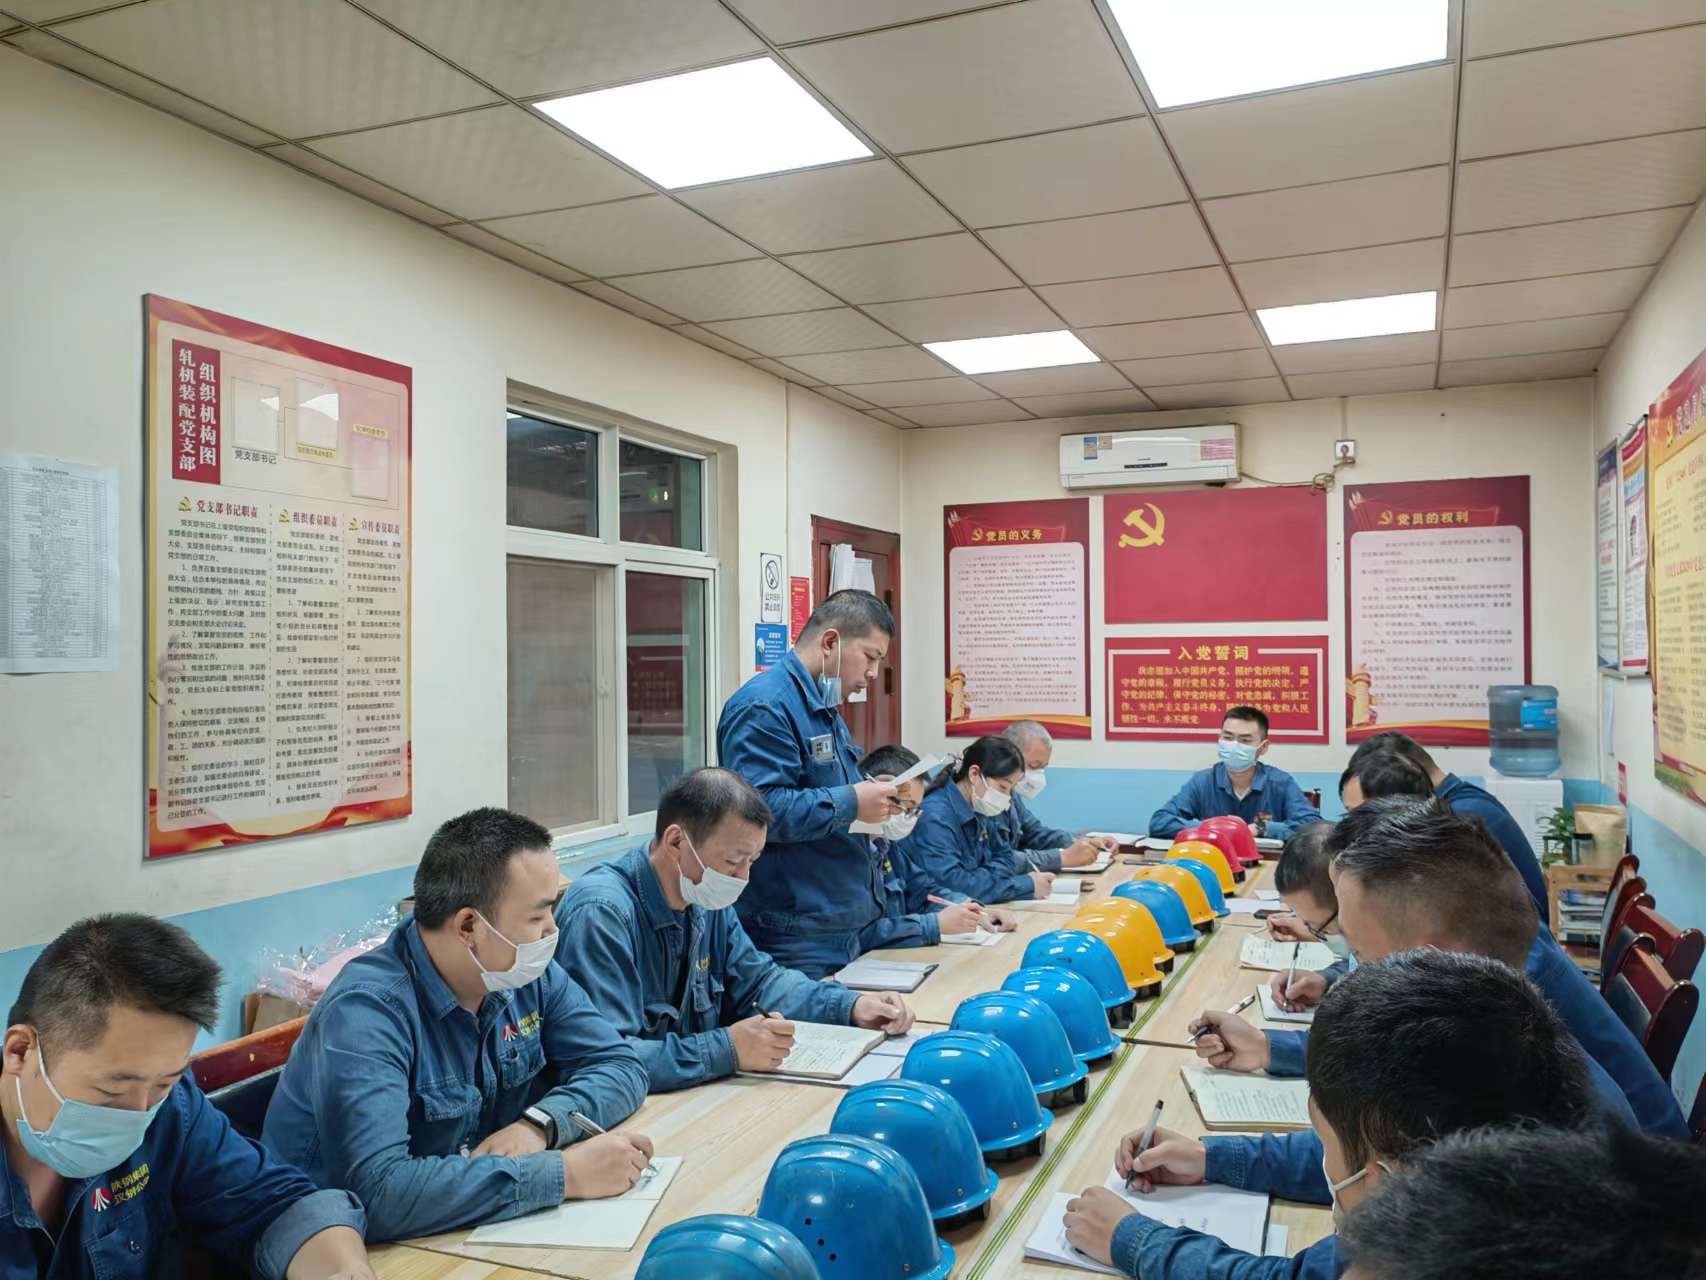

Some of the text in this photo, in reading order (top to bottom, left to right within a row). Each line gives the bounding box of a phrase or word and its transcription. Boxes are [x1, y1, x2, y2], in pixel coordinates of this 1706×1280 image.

[178, 347, 196, 473] 轧机装配党支部
[199, 361, 217, 467] 组织机构图
[234, 449, 277, 465] 党支部书记
[197, 499, 257, 518] 党支部书记职责
[293, 511, 336, 527] 组织委员职责
[1396, 510, 1470, 526] 党员的权利
[361, 519, 399, 534] 宣传委员职责
[985, 528, 1043, 542] 党员的义务
[168, 551, 218, 562] 党支部的日常工作。
[1177, 645, 1250, 661] 入党誓词
